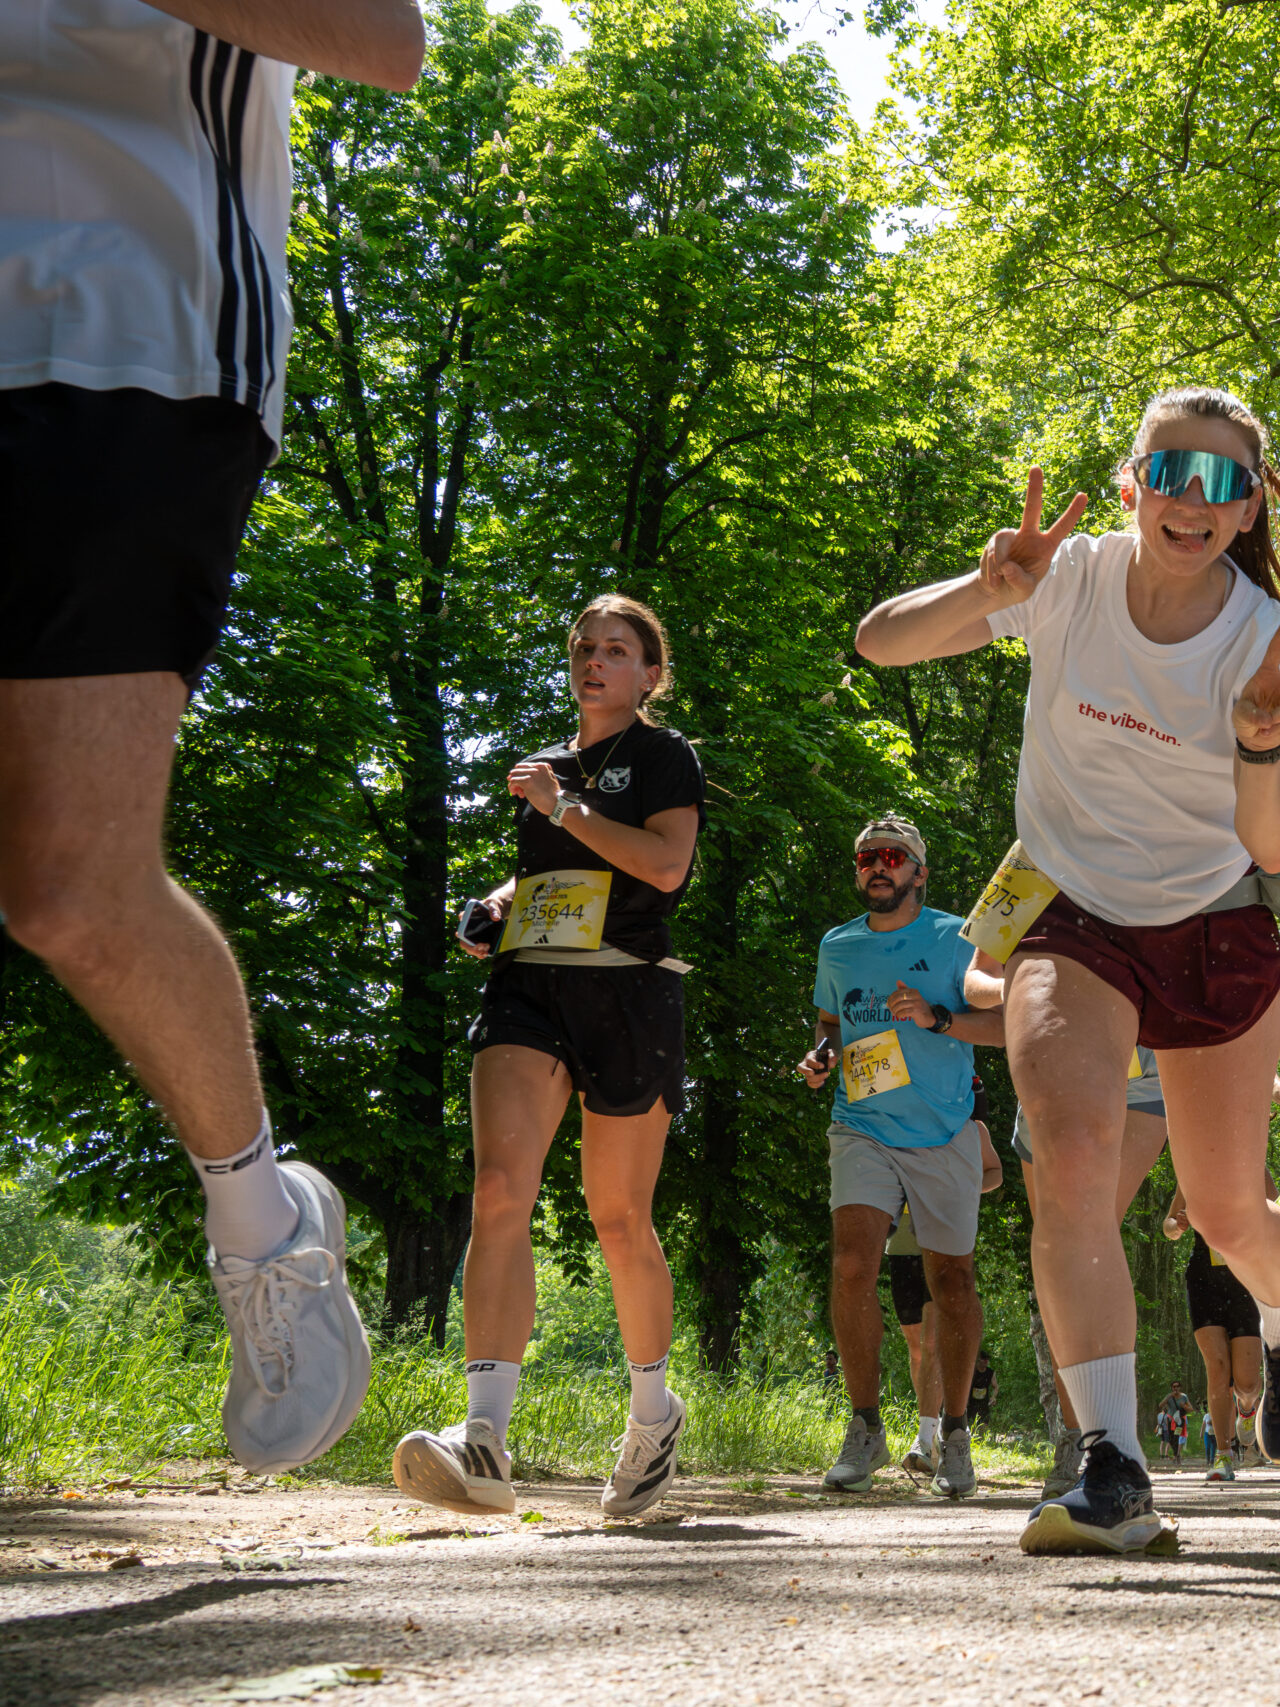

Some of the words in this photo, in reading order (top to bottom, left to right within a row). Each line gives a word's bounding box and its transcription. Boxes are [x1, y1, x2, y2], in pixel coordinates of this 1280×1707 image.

[1078, 702, 1107, 722] the
[1110, 713, 1147, 733] vibe
[1149, 727, 1181, 747] run.
[979, 881, 1020, 917] 275
[518, 903, 584, 924] 235644
[852, 1009, 891, 1023] WORLD
[467, 1363, 497, 1373] ep
[631, 1360, 666, 1373] cep
